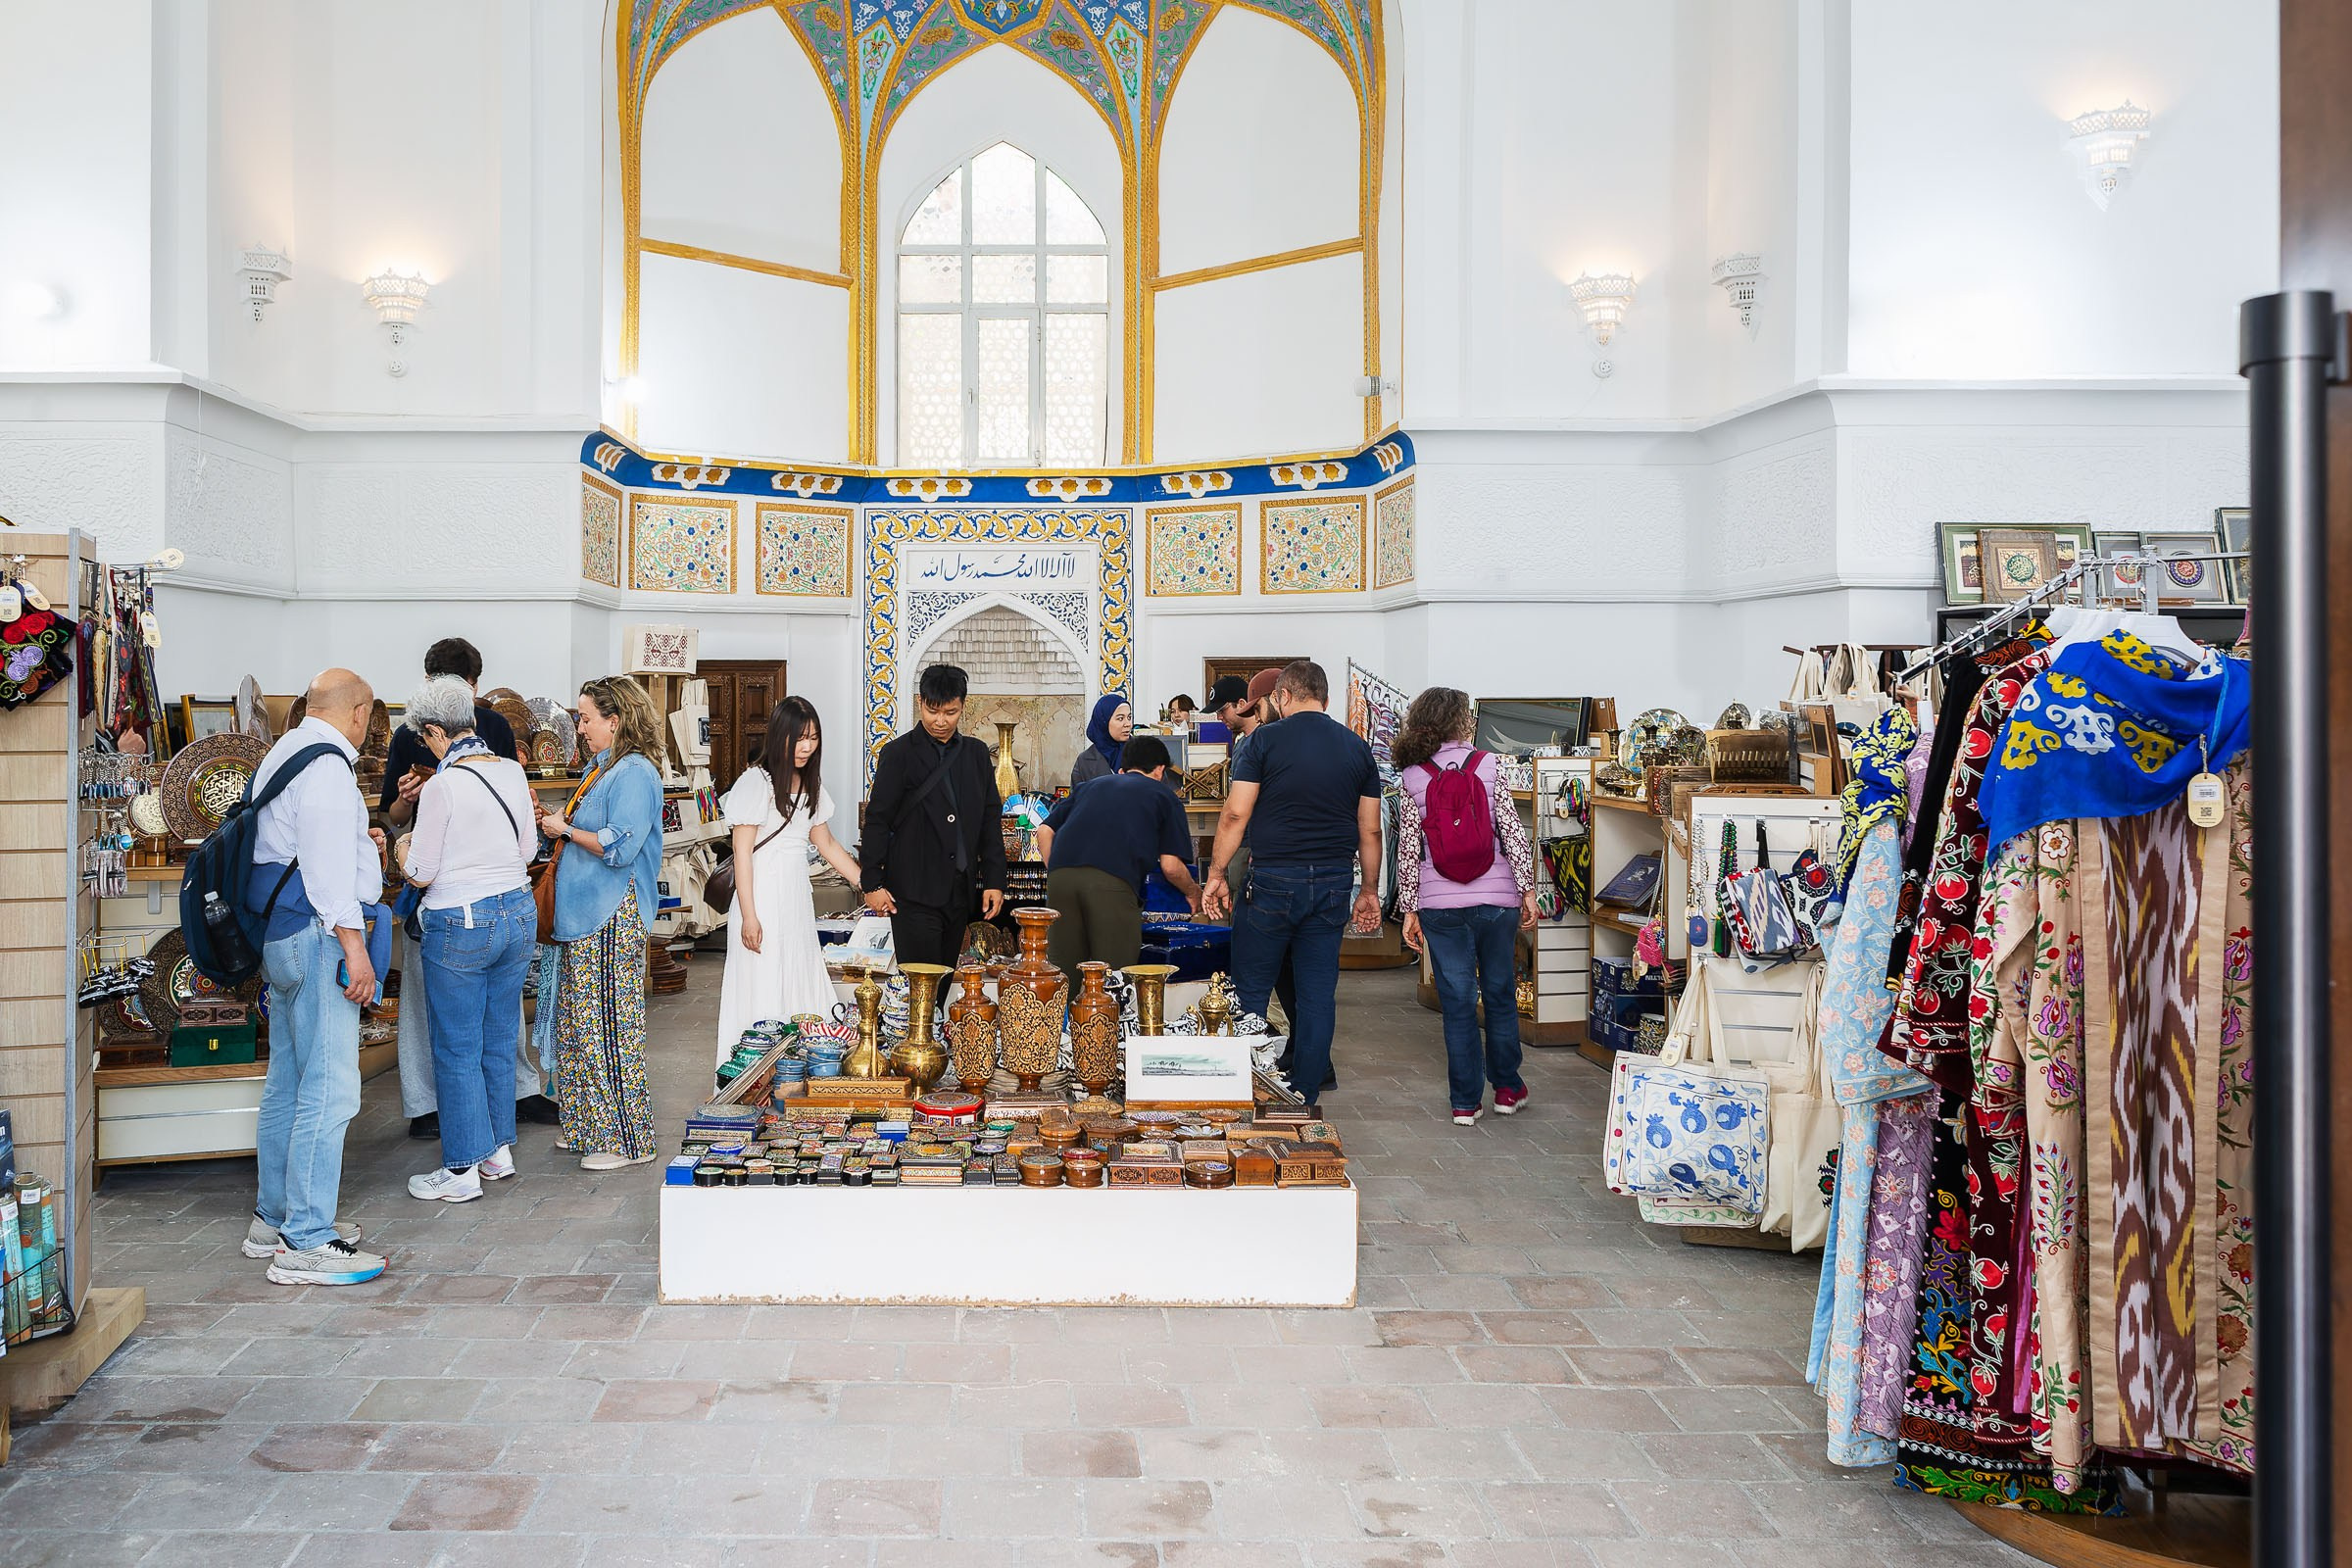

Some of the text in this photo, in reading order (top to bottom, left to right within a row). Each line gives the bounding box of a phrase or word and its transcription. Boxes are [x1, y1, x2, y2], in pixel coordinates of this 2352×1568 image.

[920, 556, 944, 578] الله
[944, 552, 975, 582] رسول
[1016, 557, 1039, 578] الله
